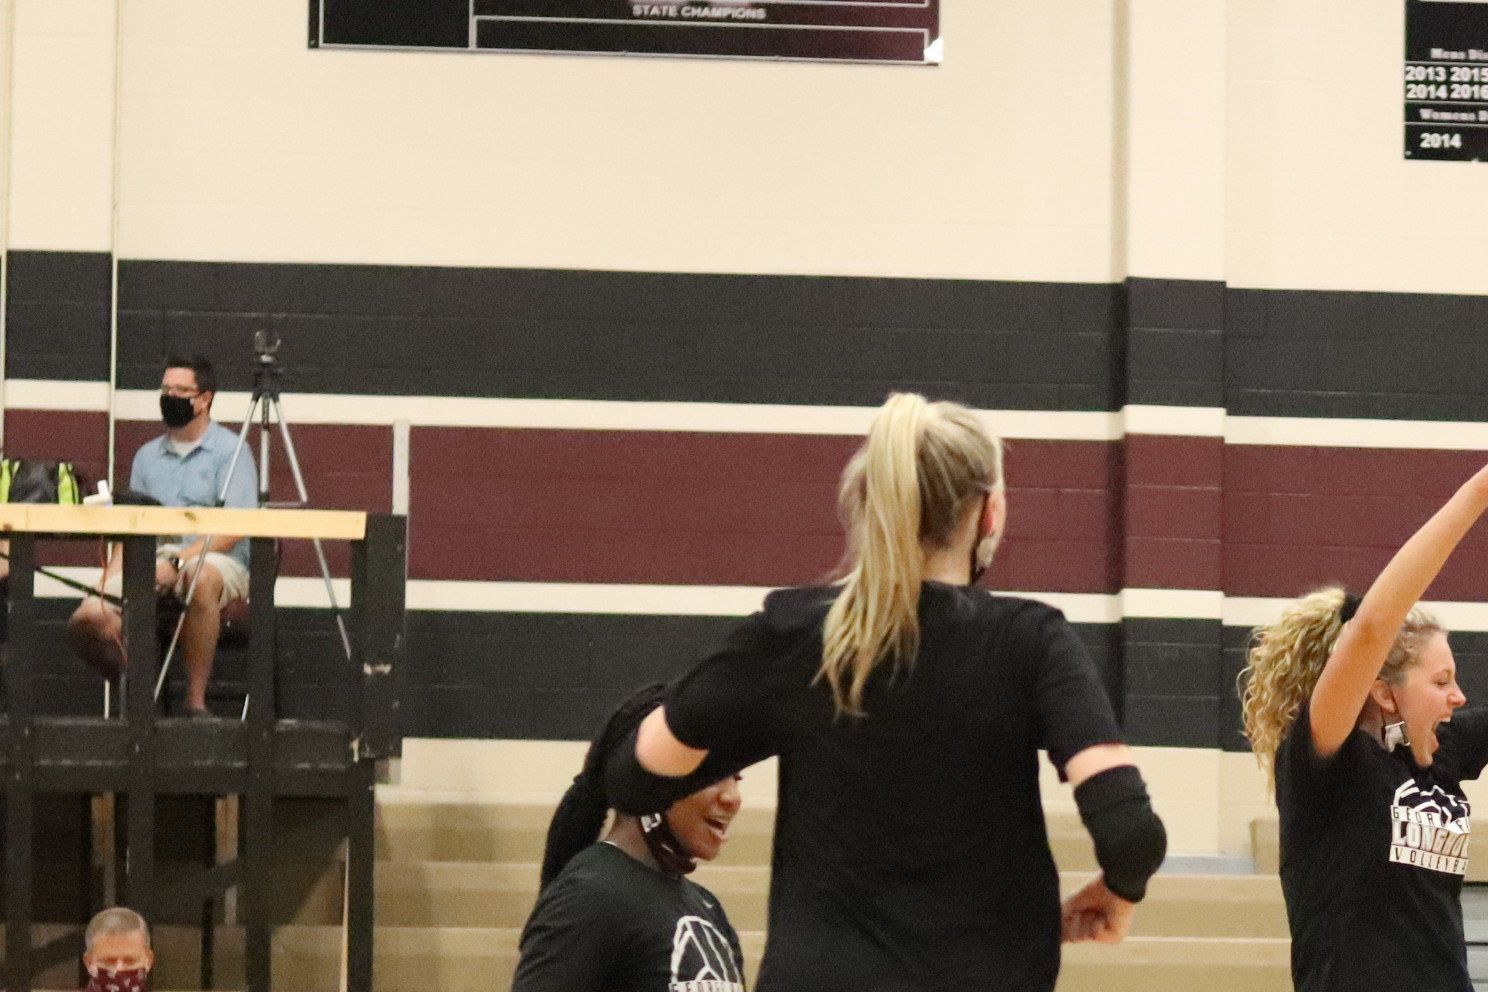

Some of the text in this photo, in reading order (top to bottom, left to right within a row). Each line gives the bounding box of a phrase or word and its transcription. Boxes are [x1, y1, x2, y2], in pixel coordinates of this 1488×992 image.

[632, 4, 767, 21] STATE CHAMPIONS
[1405, 65, 1447, 82] 2013
[1406, 83, 1448, 100] 2014
[1419, 132, 1462, 150] 2014
